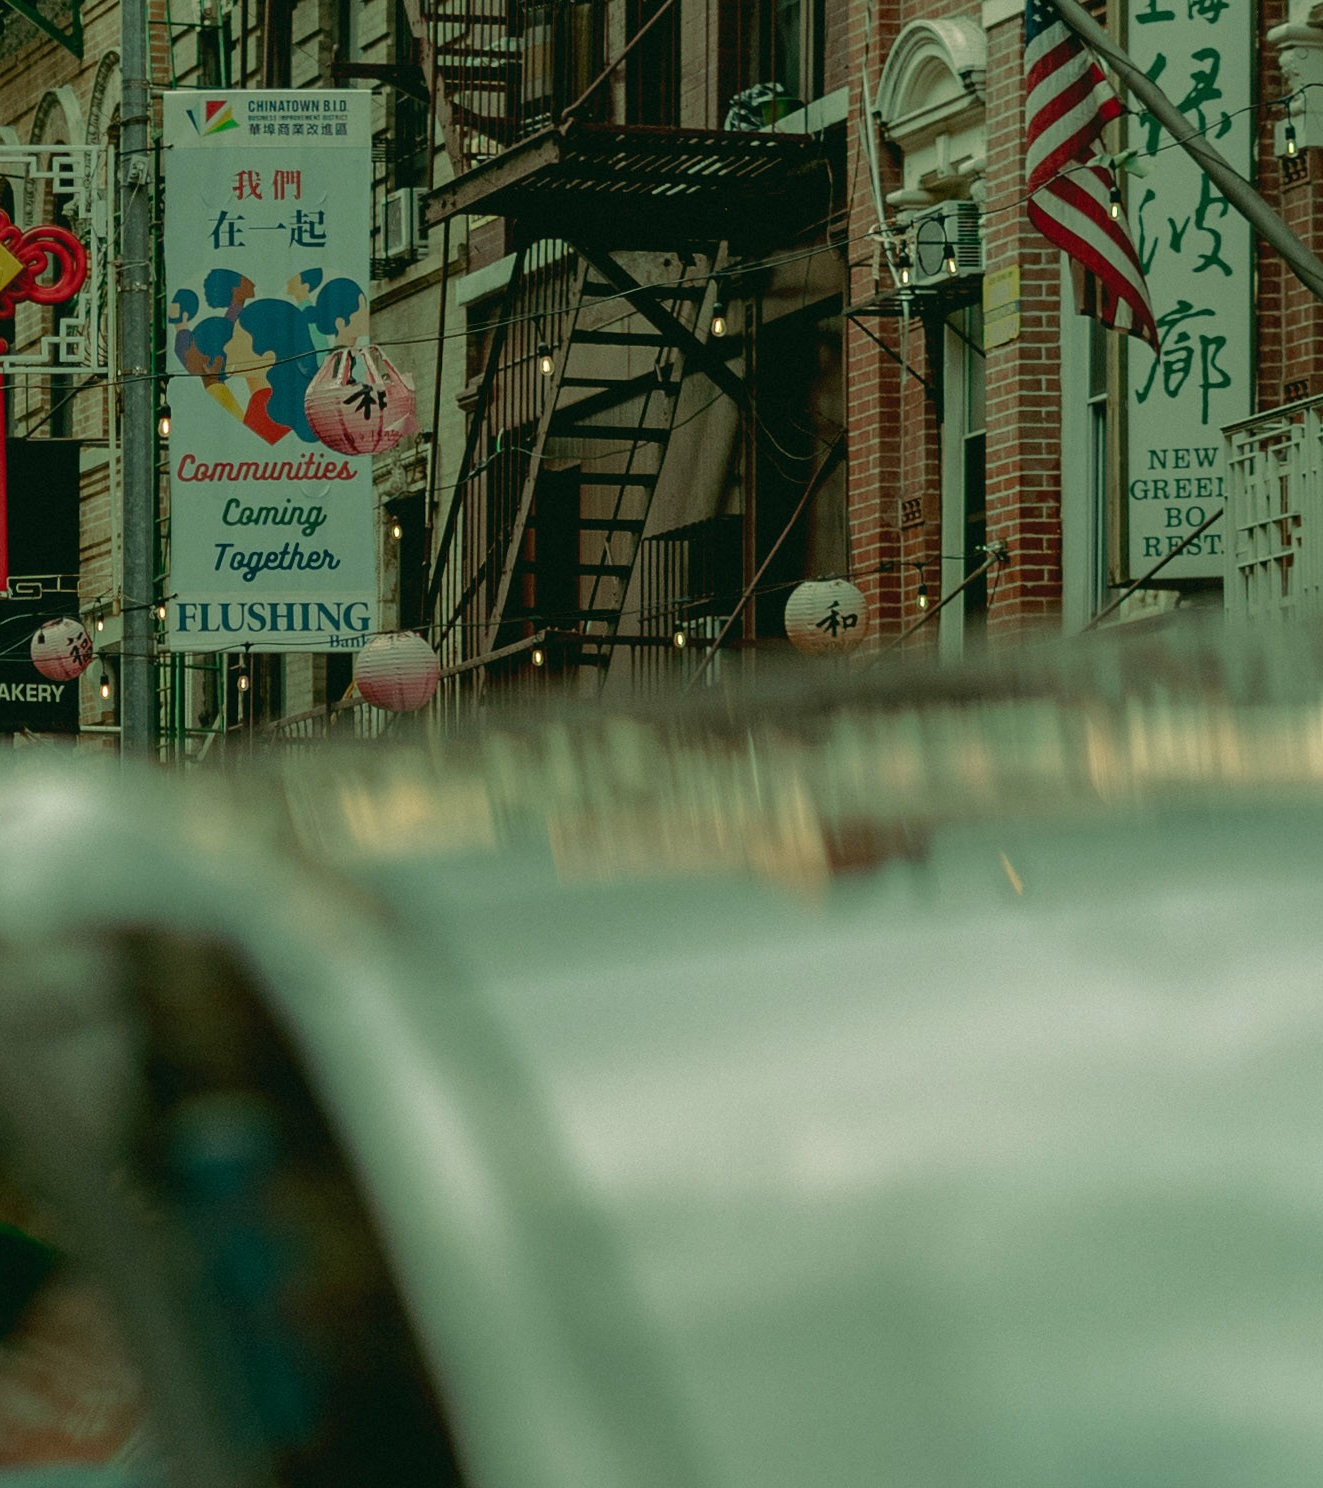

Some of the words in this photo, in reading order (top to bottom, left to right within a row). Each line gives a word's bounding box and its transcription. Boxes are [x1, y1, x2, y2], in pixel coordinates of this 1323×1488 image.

[248, 100, 320, 113] CHINATOWN
[249, 123, 348, 136] 華埠商業改進區
[232, 169, 301, 201] 我們
[208, 210, 327, 250] 在一起
[177, 452, 357, 482] Communities
[1148, 447, 1219, 470] NEW
[222, 498, 328, 537] Coming
[1165, 506, 1206, 528] BO
[1143, 534, 1224, 557] REST.
[214, 542, 341, 582] Together
[176, 602, 371, 633] FLUSHING
[816, 600, 858, 637] 和
